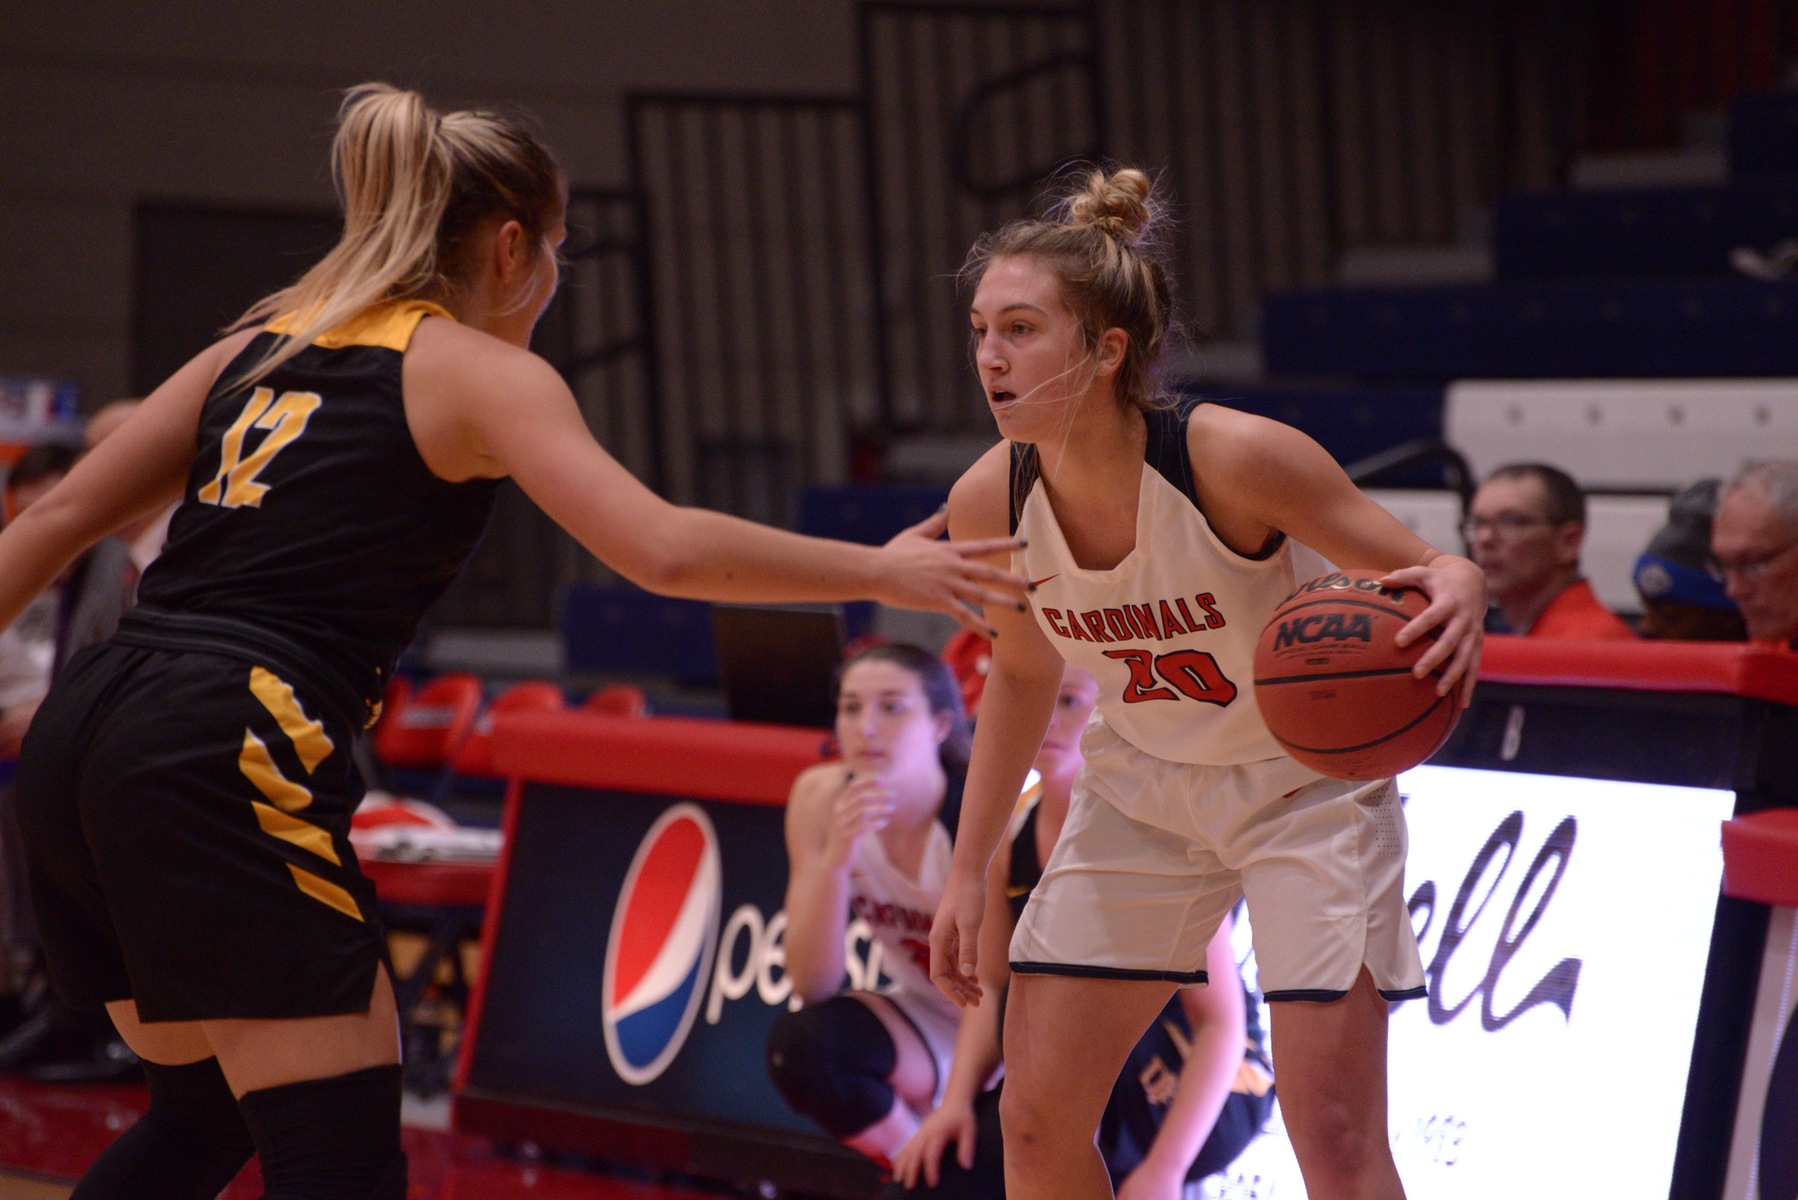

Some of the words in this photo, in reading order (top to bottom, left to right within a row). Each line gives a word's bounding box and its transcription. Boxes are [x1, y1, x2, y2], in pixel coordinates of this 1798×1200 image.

[198, 386, 322, 509] 12
[1042, 592, 1226, 642] CARDINALS
[1273, 613, 1371, 652] NCAA
[1101, 649, 1238, 708] 20
[705, 904, 883, 1013] pesi
[1389, 810, 1582, 1033] ell
